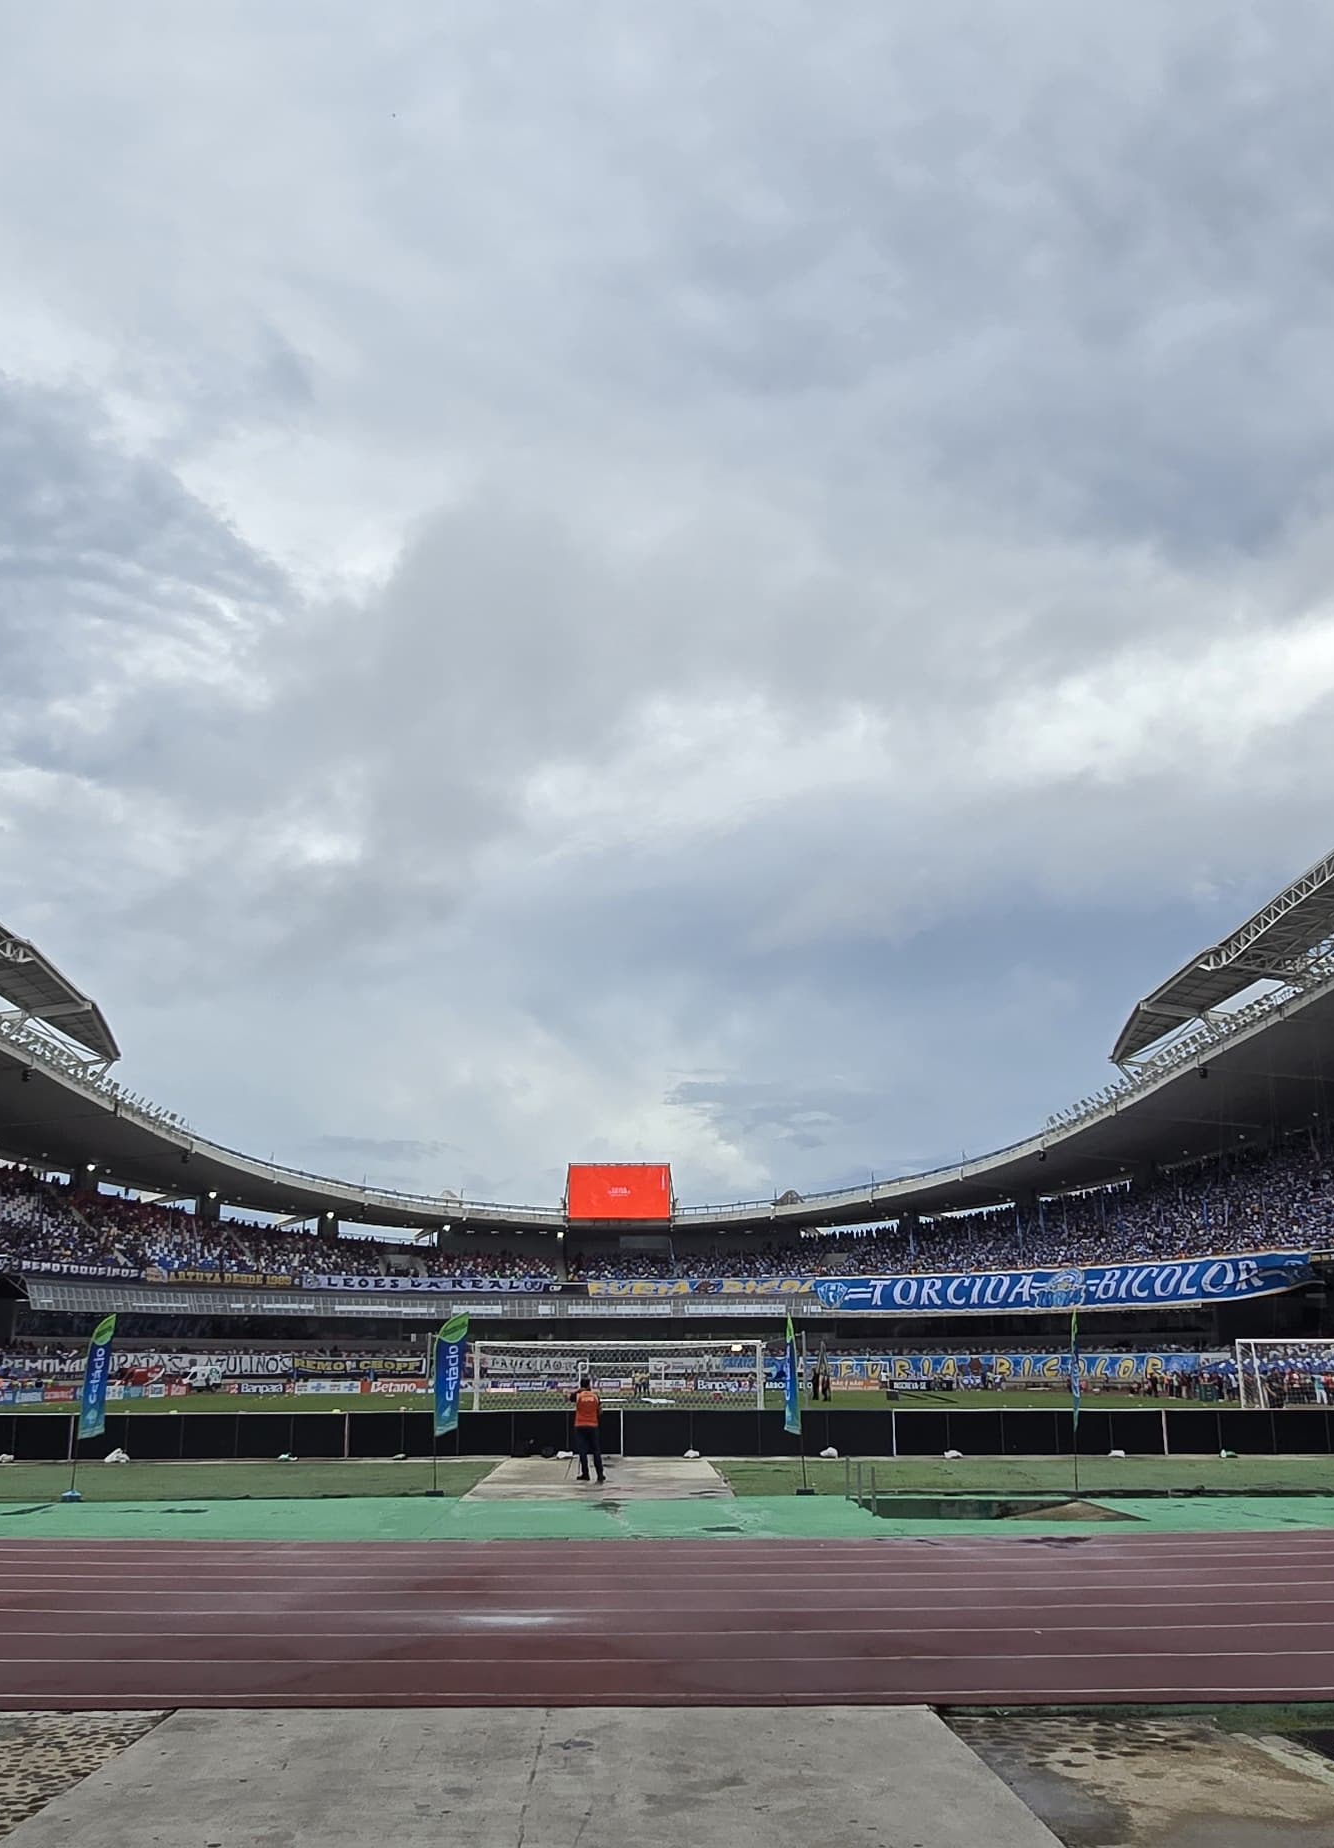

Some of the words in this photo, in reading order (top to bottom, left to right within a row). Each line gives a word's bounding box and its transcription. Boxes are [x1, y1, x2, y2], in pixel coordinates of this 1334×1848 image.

[224, 1272, 263, 1285] DESDE
[451, 1278, 520, 1290] REAL
[870, 1272, 1036, 1307] TORCIDA
[1095, 1260, 1267, 1299] BICOLOR
[109, 1352, 183, 1375] IRATAS
[294, 1358, 346, 1371] REMO
[240, 1383, 283, 1394] Banpará
[370, 1381, 417, 1393] Betano
